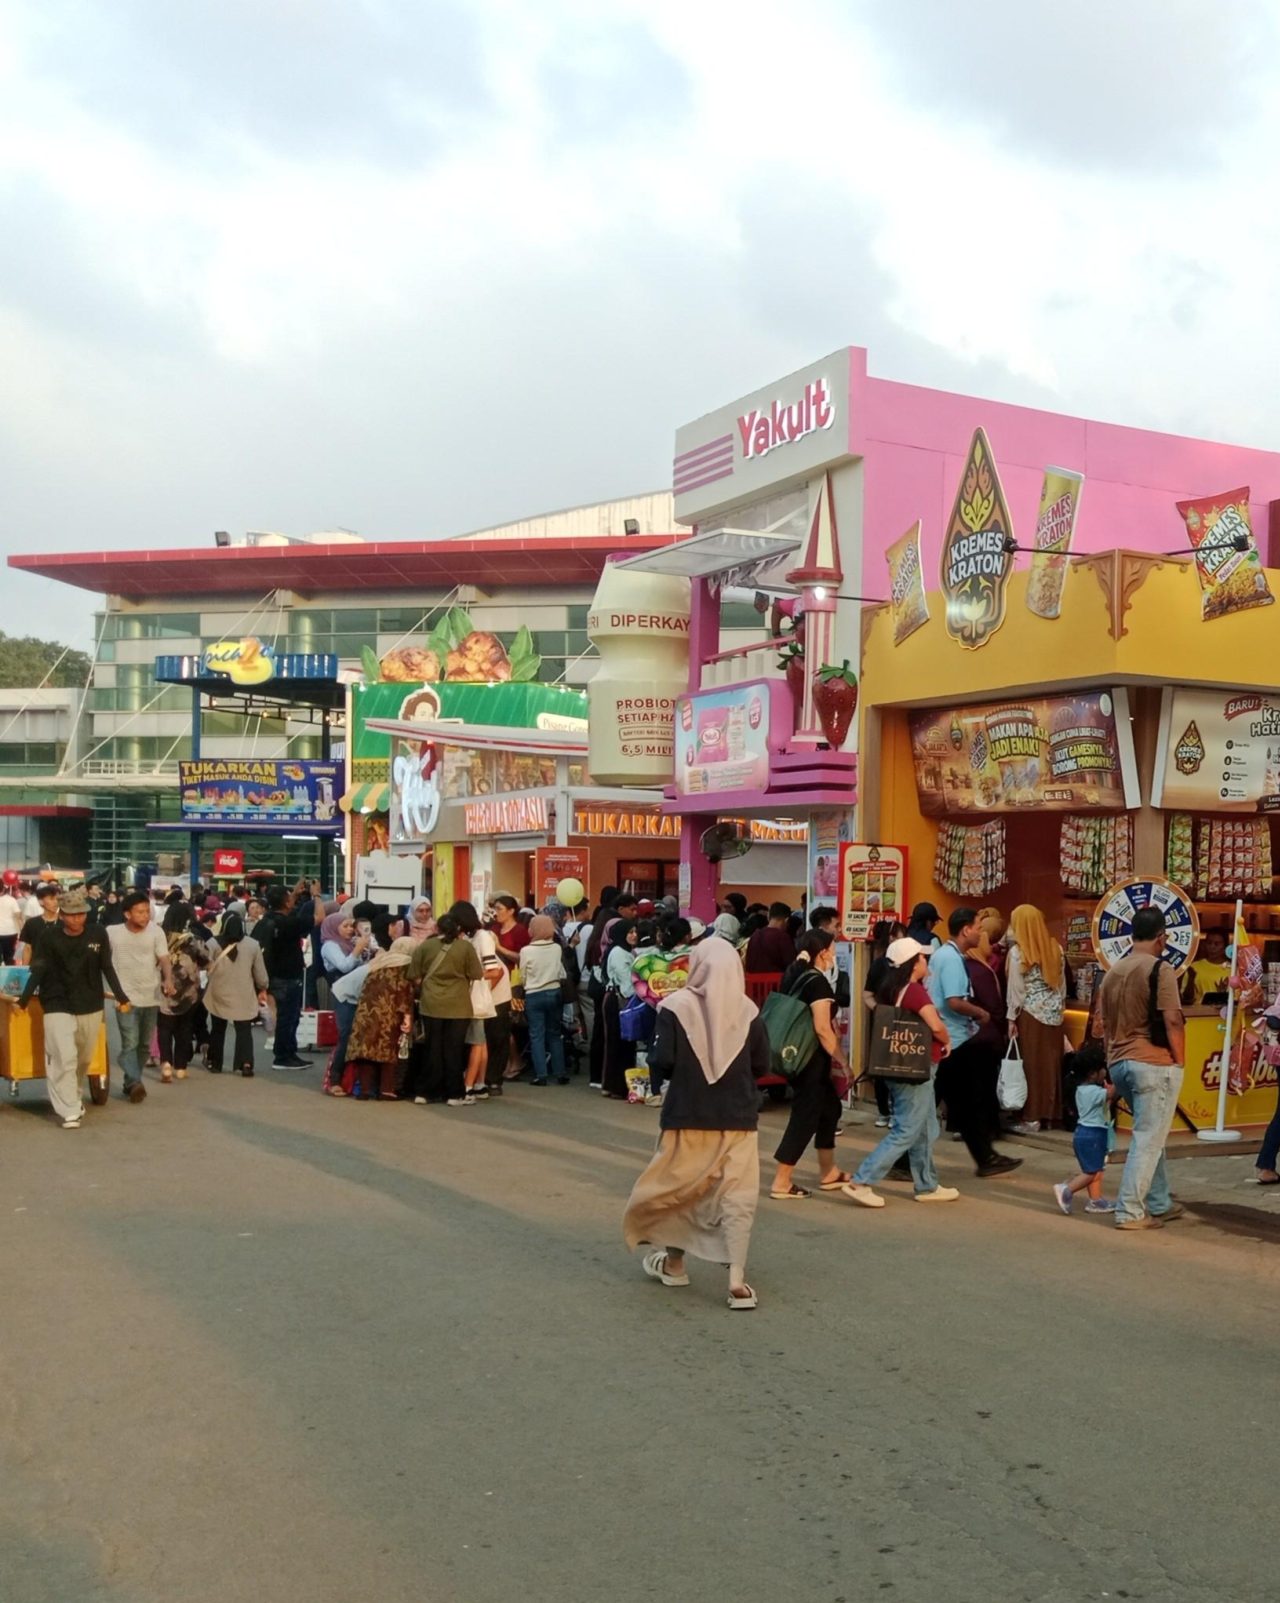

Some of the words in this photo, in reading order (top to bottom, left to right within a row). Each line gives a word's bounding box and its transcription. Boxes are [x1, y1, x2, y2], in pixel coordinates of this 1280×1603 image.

[737, 378, 835, 458] Yakult
[951, 533, 1004, 561] KREMES
[949, 555, 1004, 586] KRATON
[1228, 698, 1260, 714] BARU!
[617, 713, 658, 723] SETIAP
[989, 723, 1017, 742] MAKAN
[1018, 722, 1034, 737] APA
[991, 738, 1011, 760] JADI
[1010, 737, 1039, 756] ENAK!
[180, 762, 277, 776] TUKARKAN
[182, 775, 202, 785] TIKET
[202, 774, 231, 783] MASUK
[231, 774, 252, 783] ANDA
[881, 1027, 919, 1045] Lady
[890, 1040, 926, 1057] Rose
